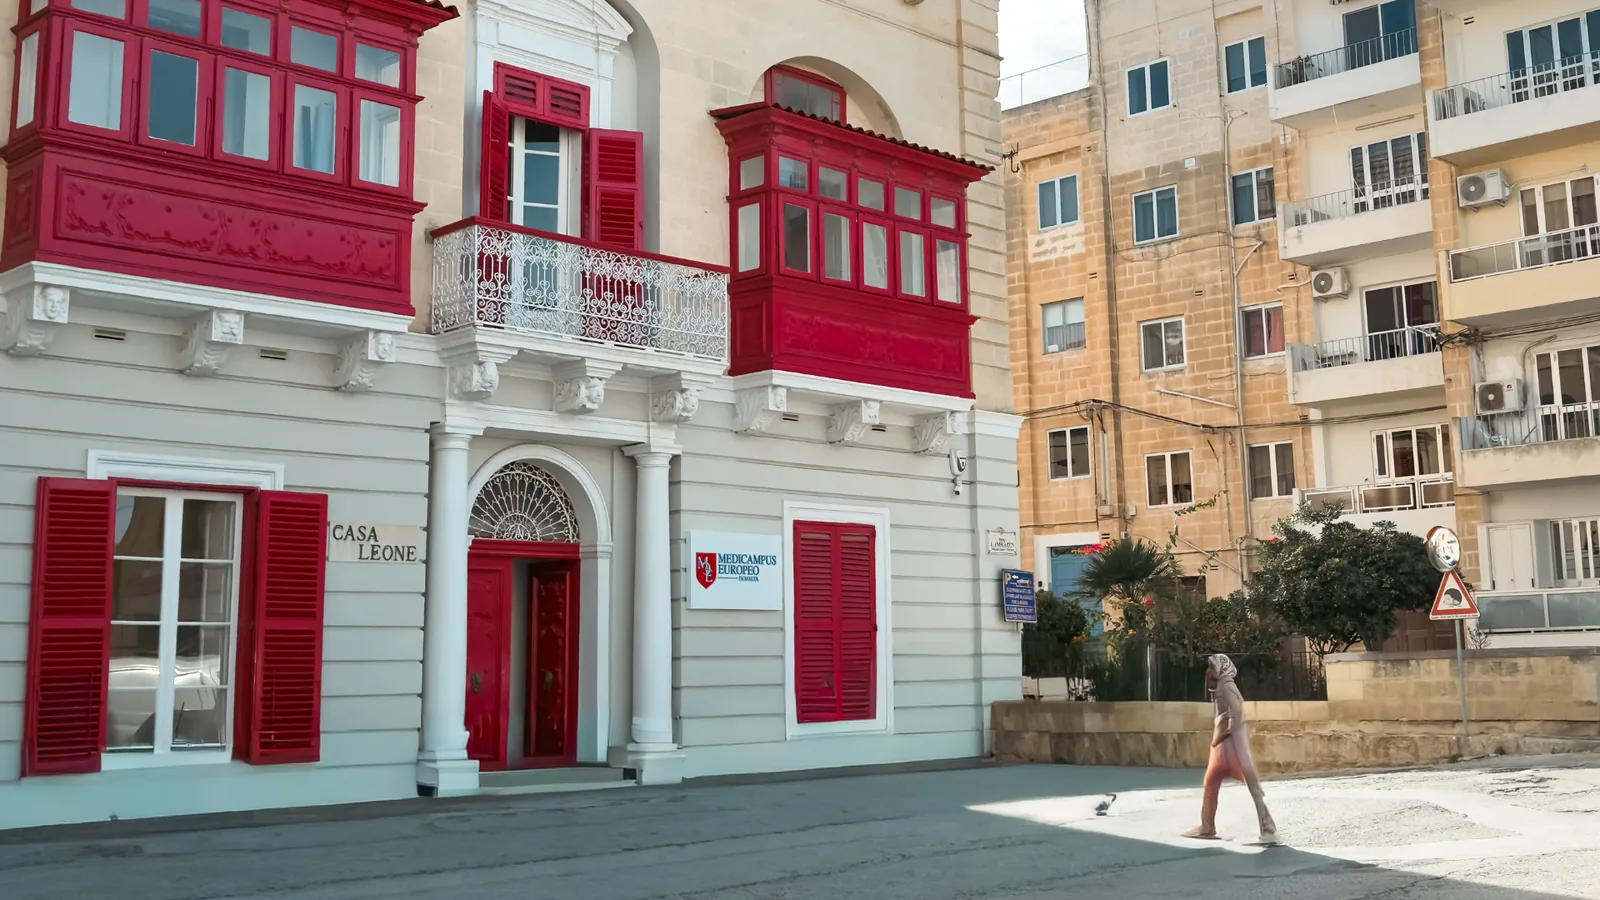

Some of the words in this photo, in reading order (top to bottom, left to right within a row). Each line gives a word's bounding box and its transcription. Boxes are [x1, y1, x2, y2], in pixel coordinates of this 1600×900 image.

[332, 524, 379, 542] CASA
[358, 543, 417, 562] LEONE
[717, 553, 777, 566] MEDICAMPUS
[717, 564, 760, 576] EUROPEO
[1004, 572, 1011, 585] P
